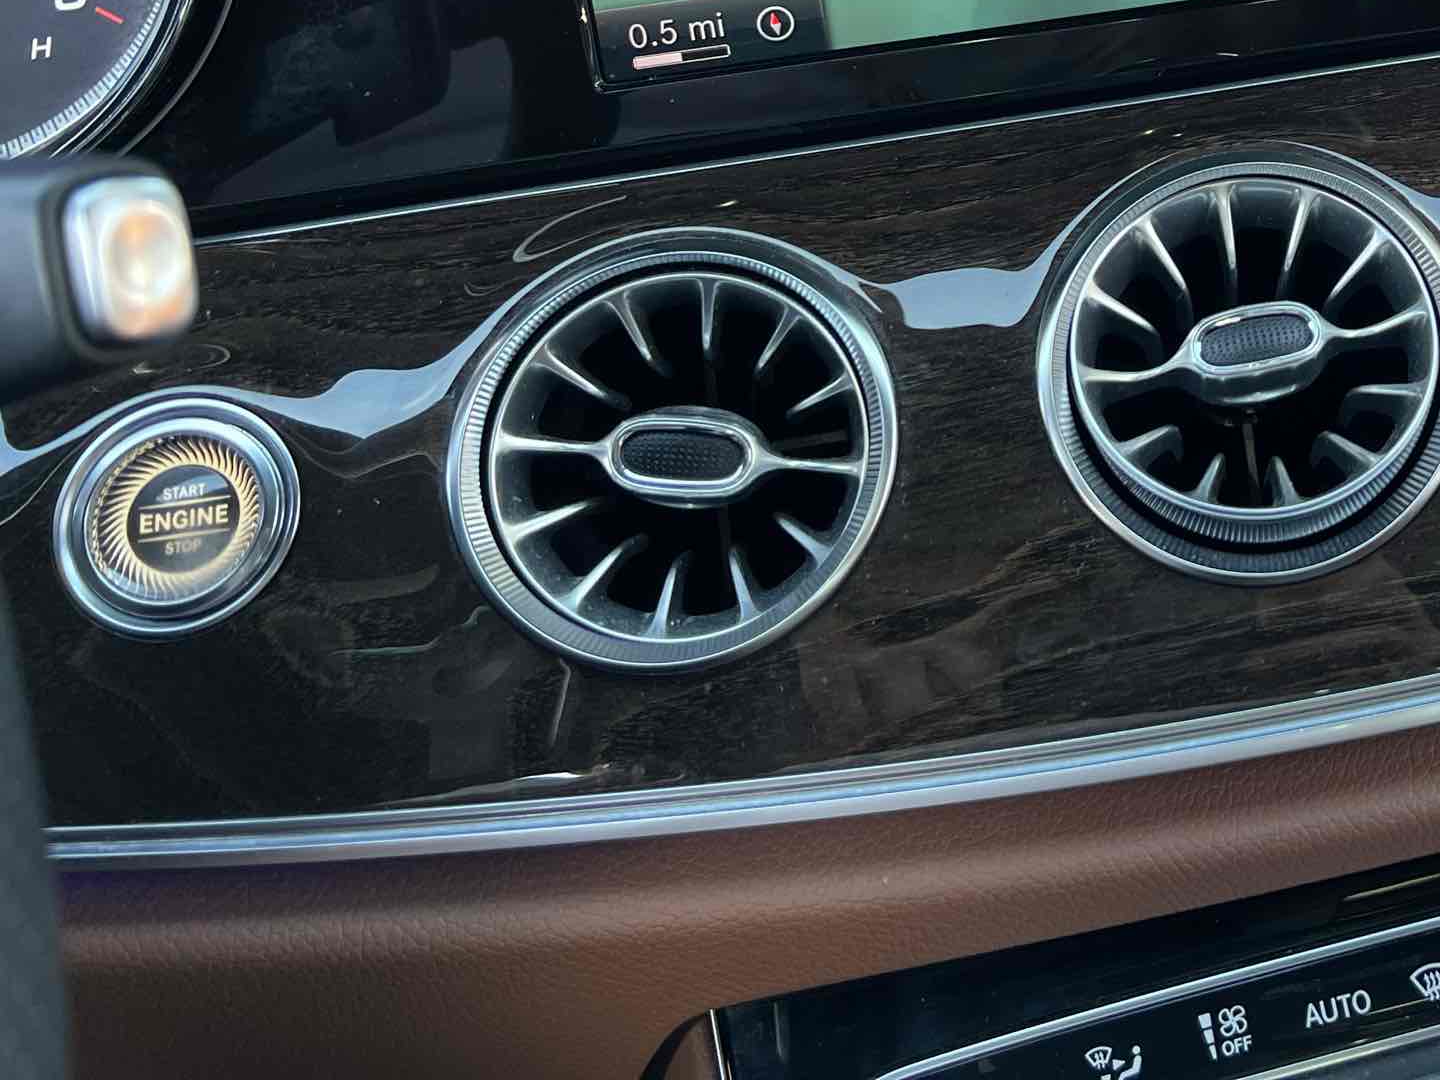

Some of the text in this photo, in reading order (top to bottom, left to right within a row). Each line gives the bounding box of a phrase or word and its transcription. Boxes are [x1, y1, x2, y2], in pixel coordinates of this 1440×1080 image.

[628, 11, 726, 49] 0.5 mi
[30, 36, 52, 60] H
[162, 483, 206, 501] START
[138, 503, 229, 535] ENGINE
[164, 540, 203, 556] STOP
[1304, 989, 1372, 1029] AUTO
[1221, 1035, 1253, 1057] OFF
